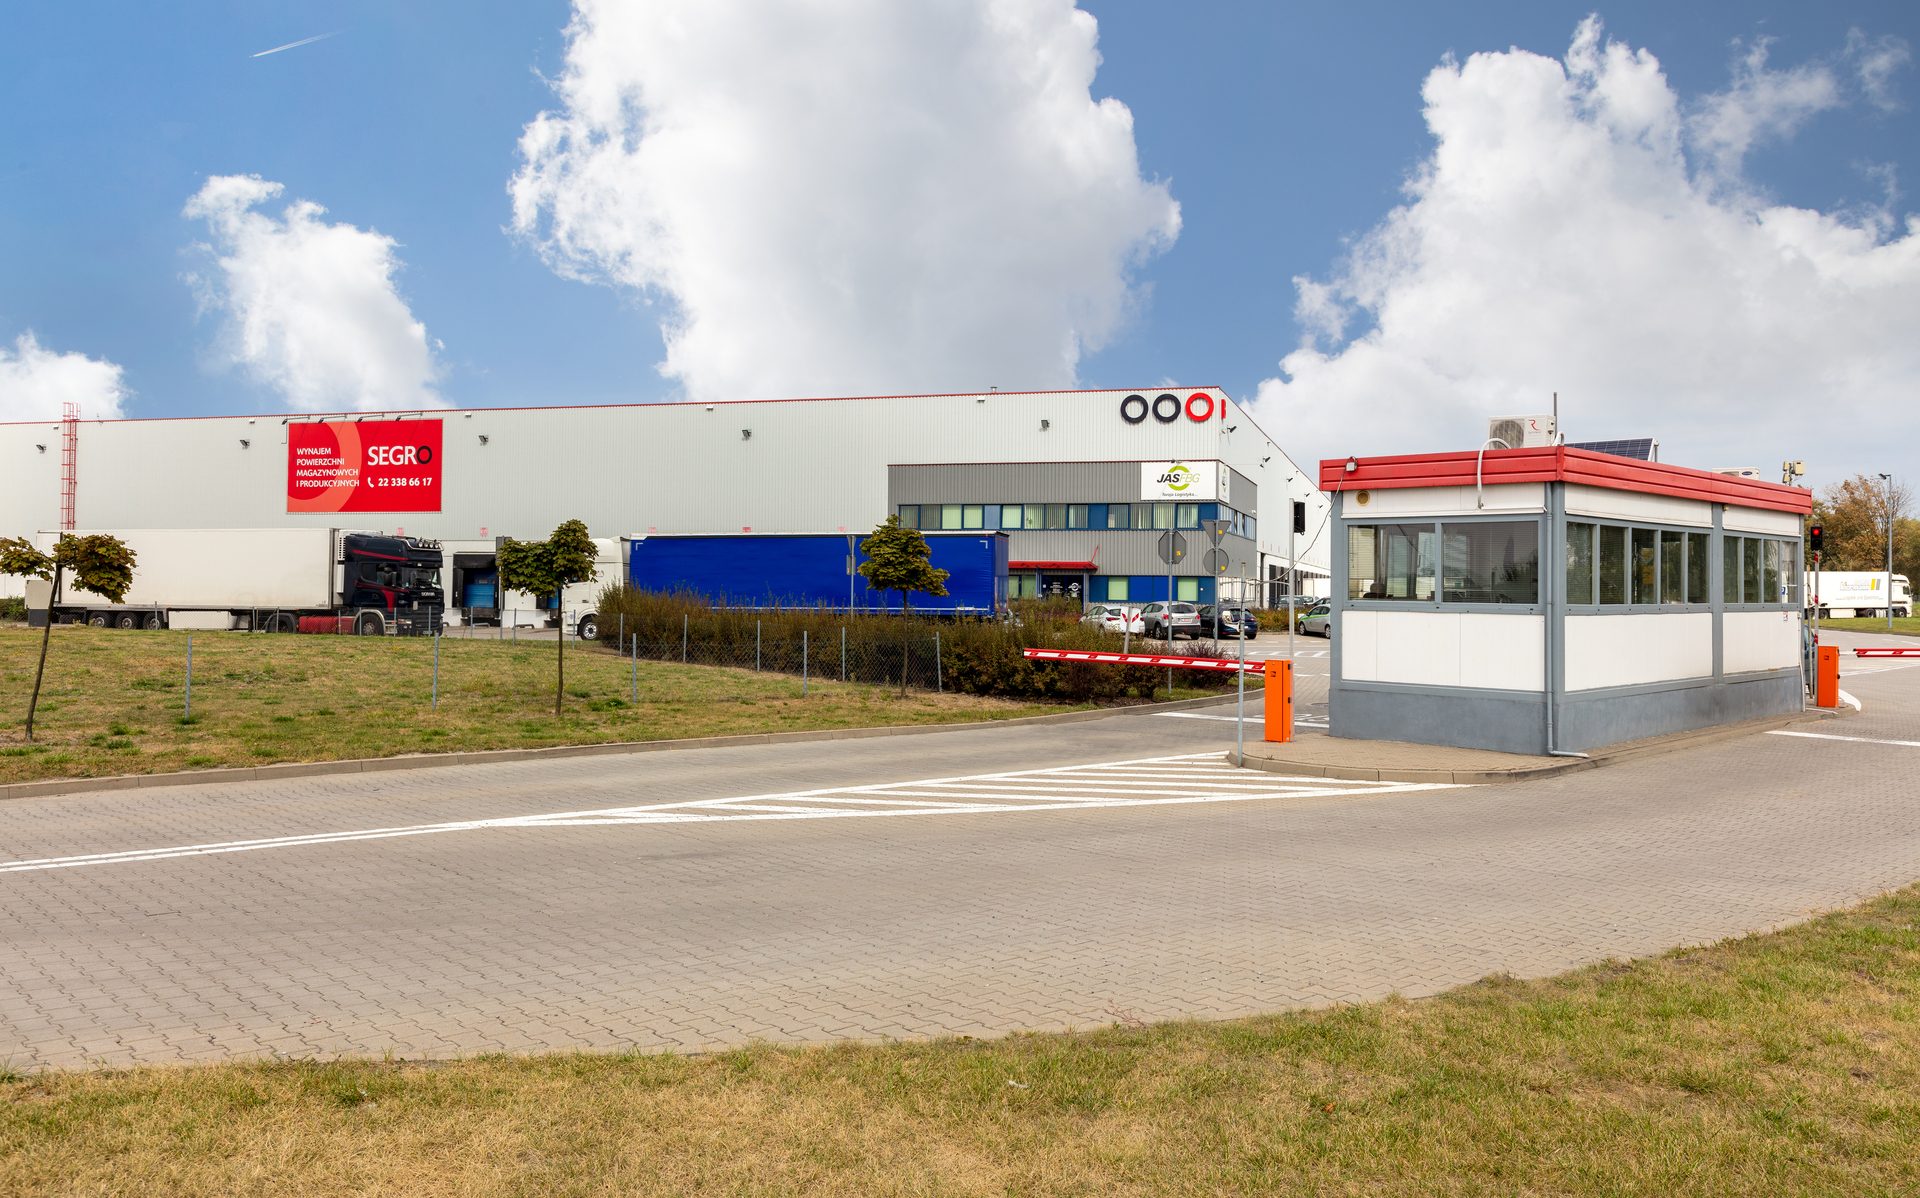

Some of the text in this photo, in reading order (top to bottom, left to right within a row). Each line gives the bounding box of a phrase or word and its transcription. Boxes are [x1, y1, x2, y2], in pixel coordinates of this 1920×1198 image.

[296, 447, 332, 455] WYNAJEM
[368, 445, 432, 466] SEGRO
[296, 458, 345, 466] POWIERZCHNI
[296, 469, 359, 477] MAGAZYNOWYCH
[300, 480, 360, 488] PRODUKCYJNYCH
[378, 477, 432, 487] 22 338 66 17
